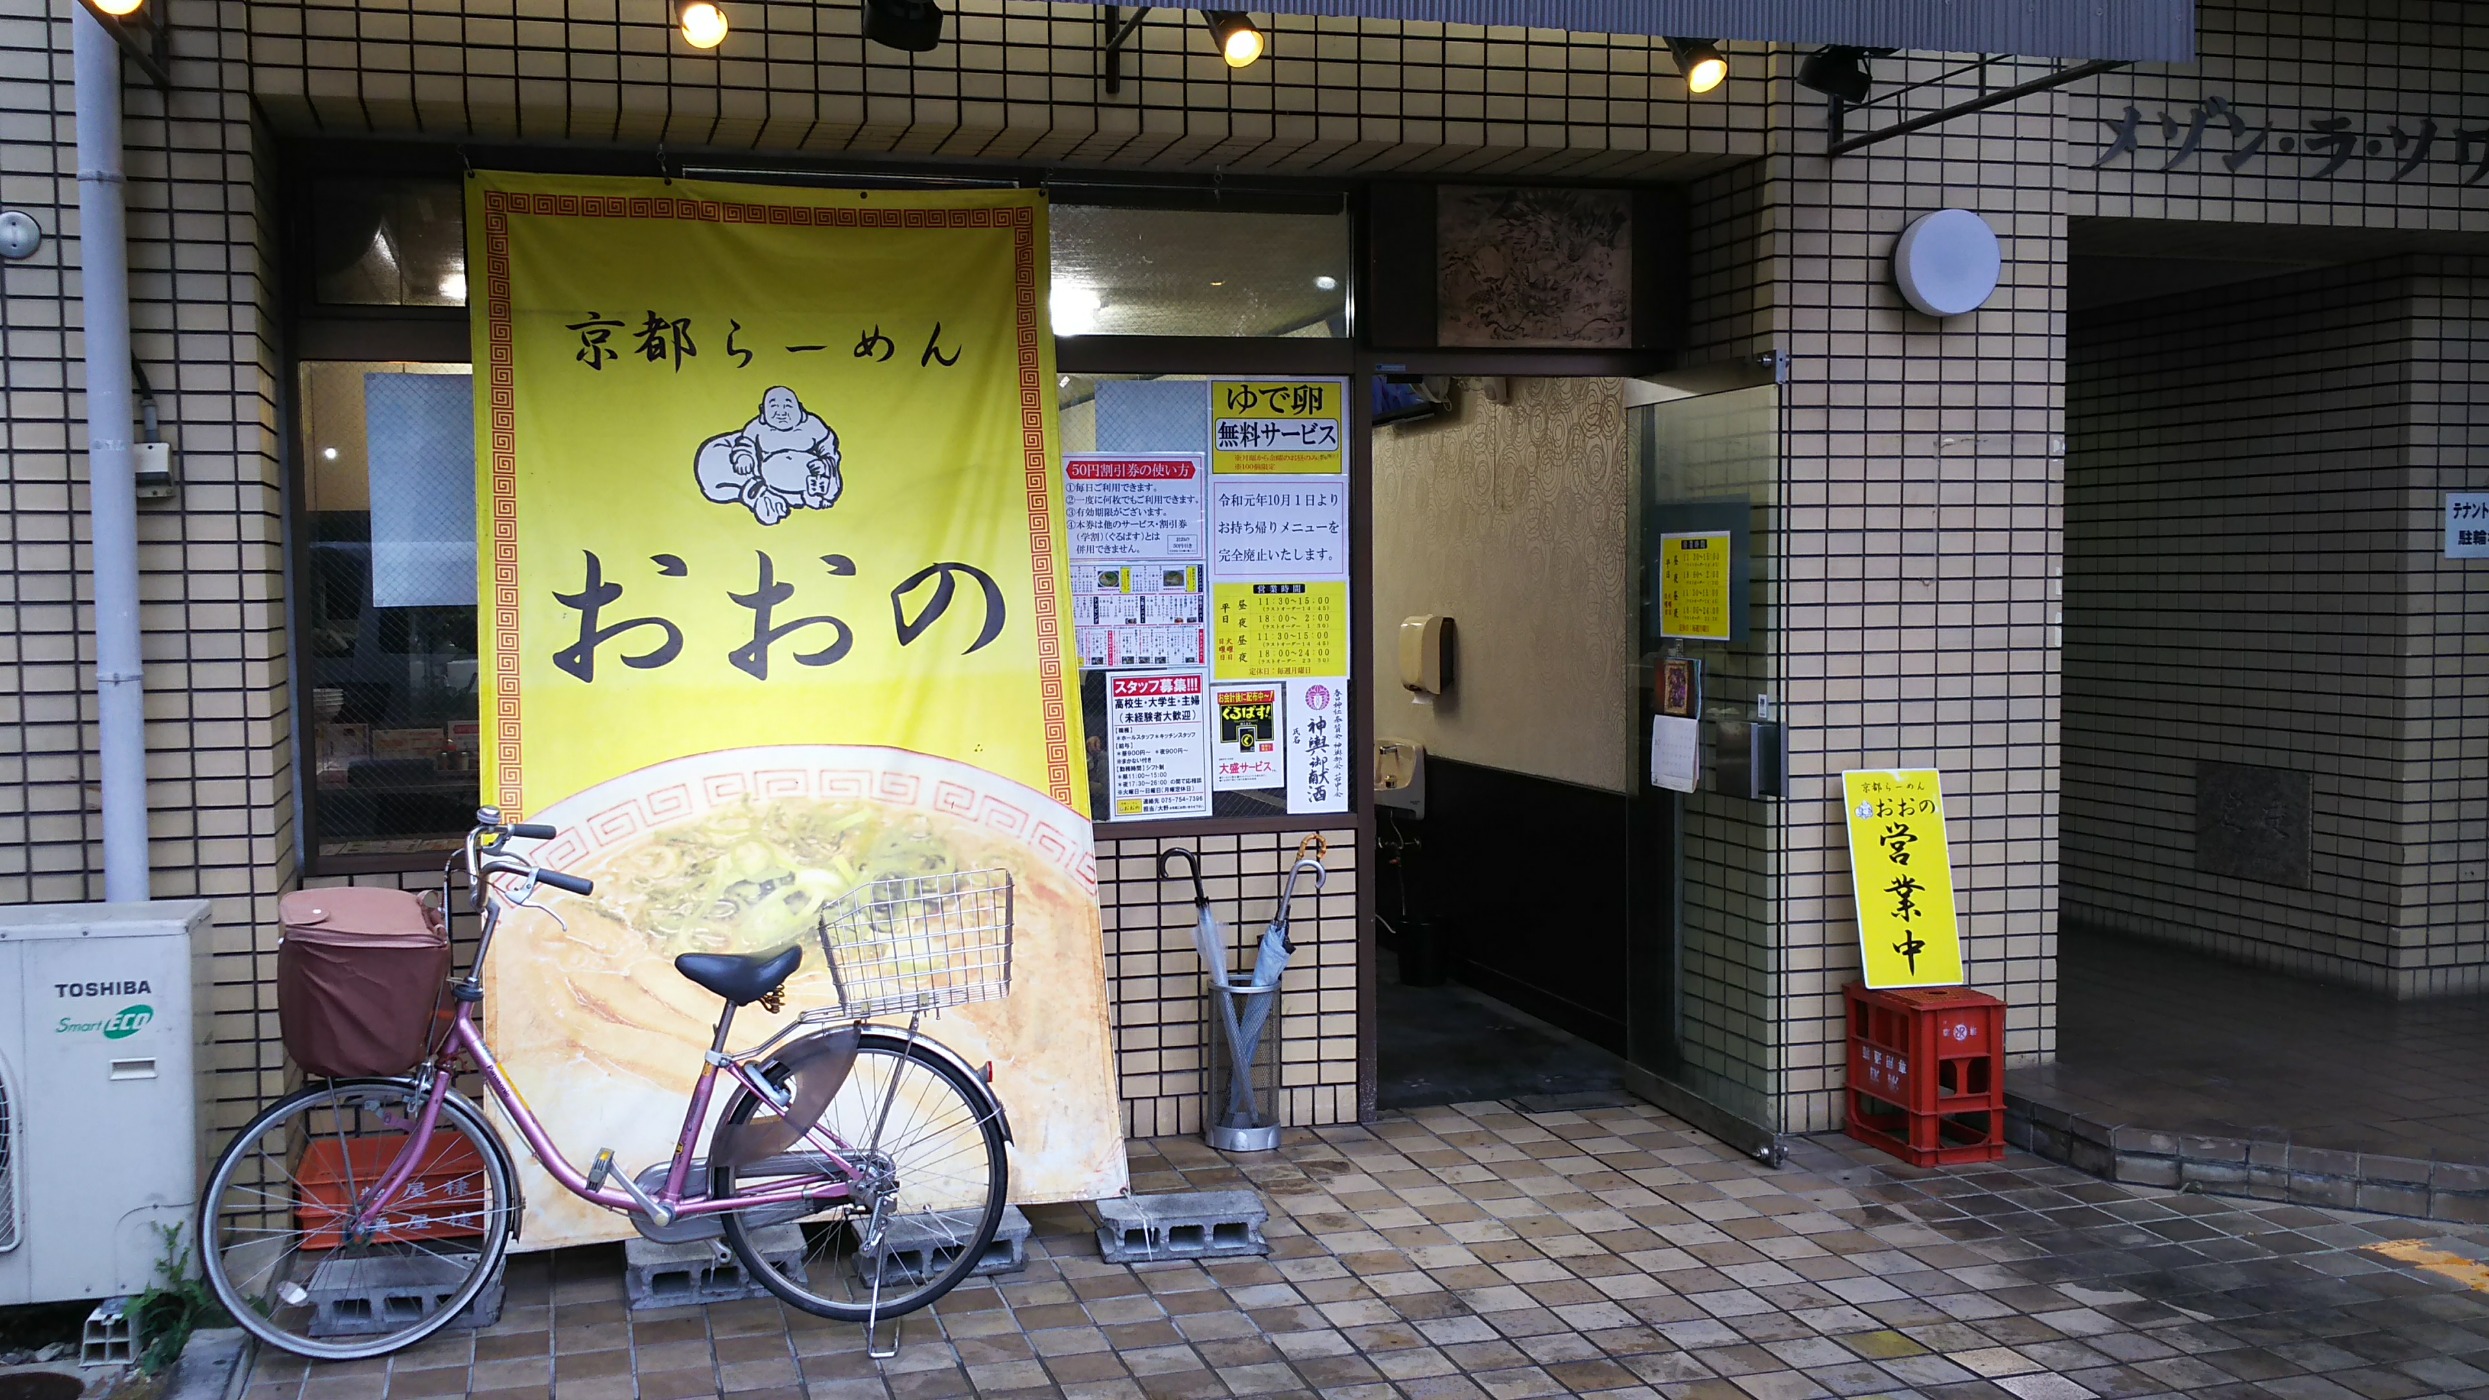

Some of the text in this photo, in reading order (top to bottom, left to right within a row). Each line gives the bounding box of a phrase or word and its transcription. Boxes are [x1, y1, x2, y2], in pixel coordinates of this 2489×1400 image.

[566, 311, 962, 374] 京都らーめん
[1227, 384, 1324, 416] ゆで卵
[1217, 421, 1337, 449] 無料サービス
[1071, 463, 1191, 478] 50円割引券の使い方
[2453, 502, 2489, 519] テナント
[1218, 521, 1340, 535] お持ち帰りメニューを
[2458, 530, 2489, 545] 駐輪
[1218, 549, 1334, 562] 完全廃止いたします。
[1221, 602, 1231, 624] 平日
[1238, 599, 1248, 611] 昼
[552, 549, 1007, 683] おおの
[1238, 617, 1248, 628] 夜
[1238, 634, 1248, 646] 昼
[1238, 652, 1248, 663] 夜
[1114, 677, 1199, 694] スタッフ募集!!!
[1114, 695, 1200, 709] 高校生・大学生・主婦
[1292, 727, 1301, 745] 氏名
[1218, 761, 1272, 775] 大盛サービス
[1860, 781, 1926, 793] 京都らーめん
[1875, 797, 1937, 818] おおの
[1879, 821, 1926, 977] 営業中
[54, 980, 152, 998] TOSHIBA
